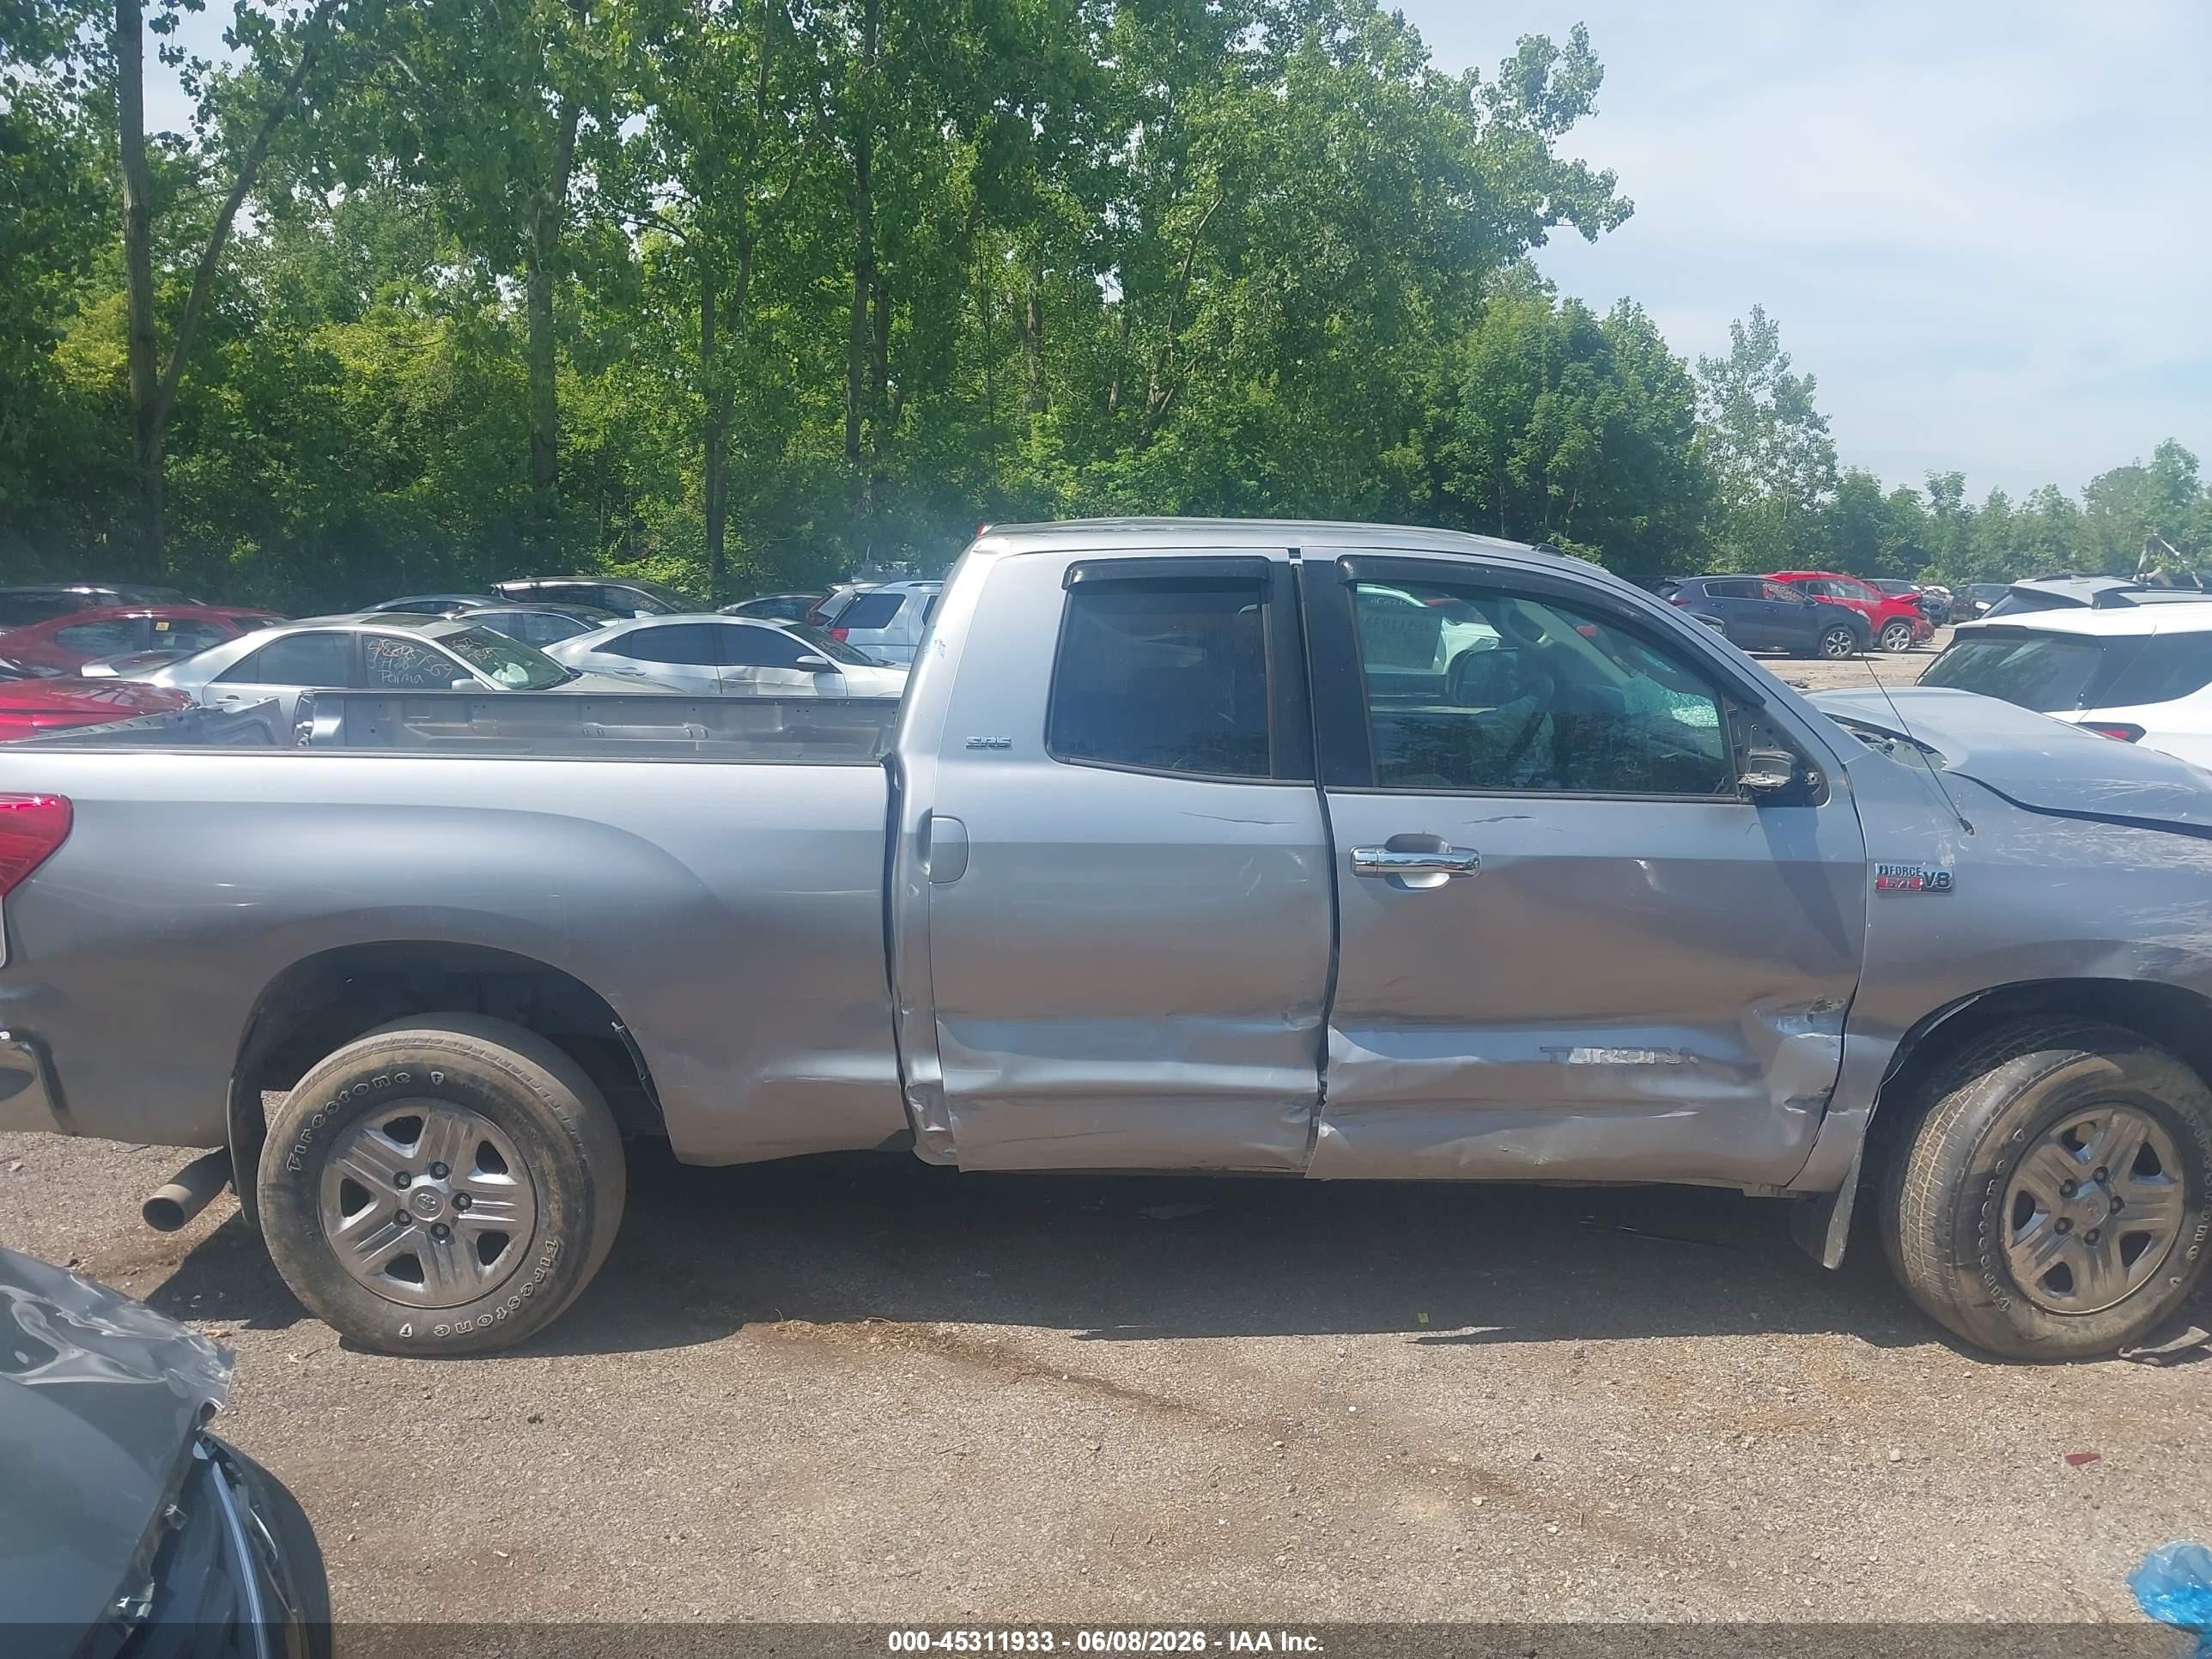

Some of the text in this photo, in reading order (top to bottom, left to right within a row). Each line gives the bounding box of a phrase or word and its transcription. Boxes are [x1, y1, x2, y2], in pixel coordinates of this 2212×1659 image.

[1923, 872, 1951, 889] V8
[287, 1071, 411, 1172] Firestone
[434, 1238, 559, 1337] Firestone
